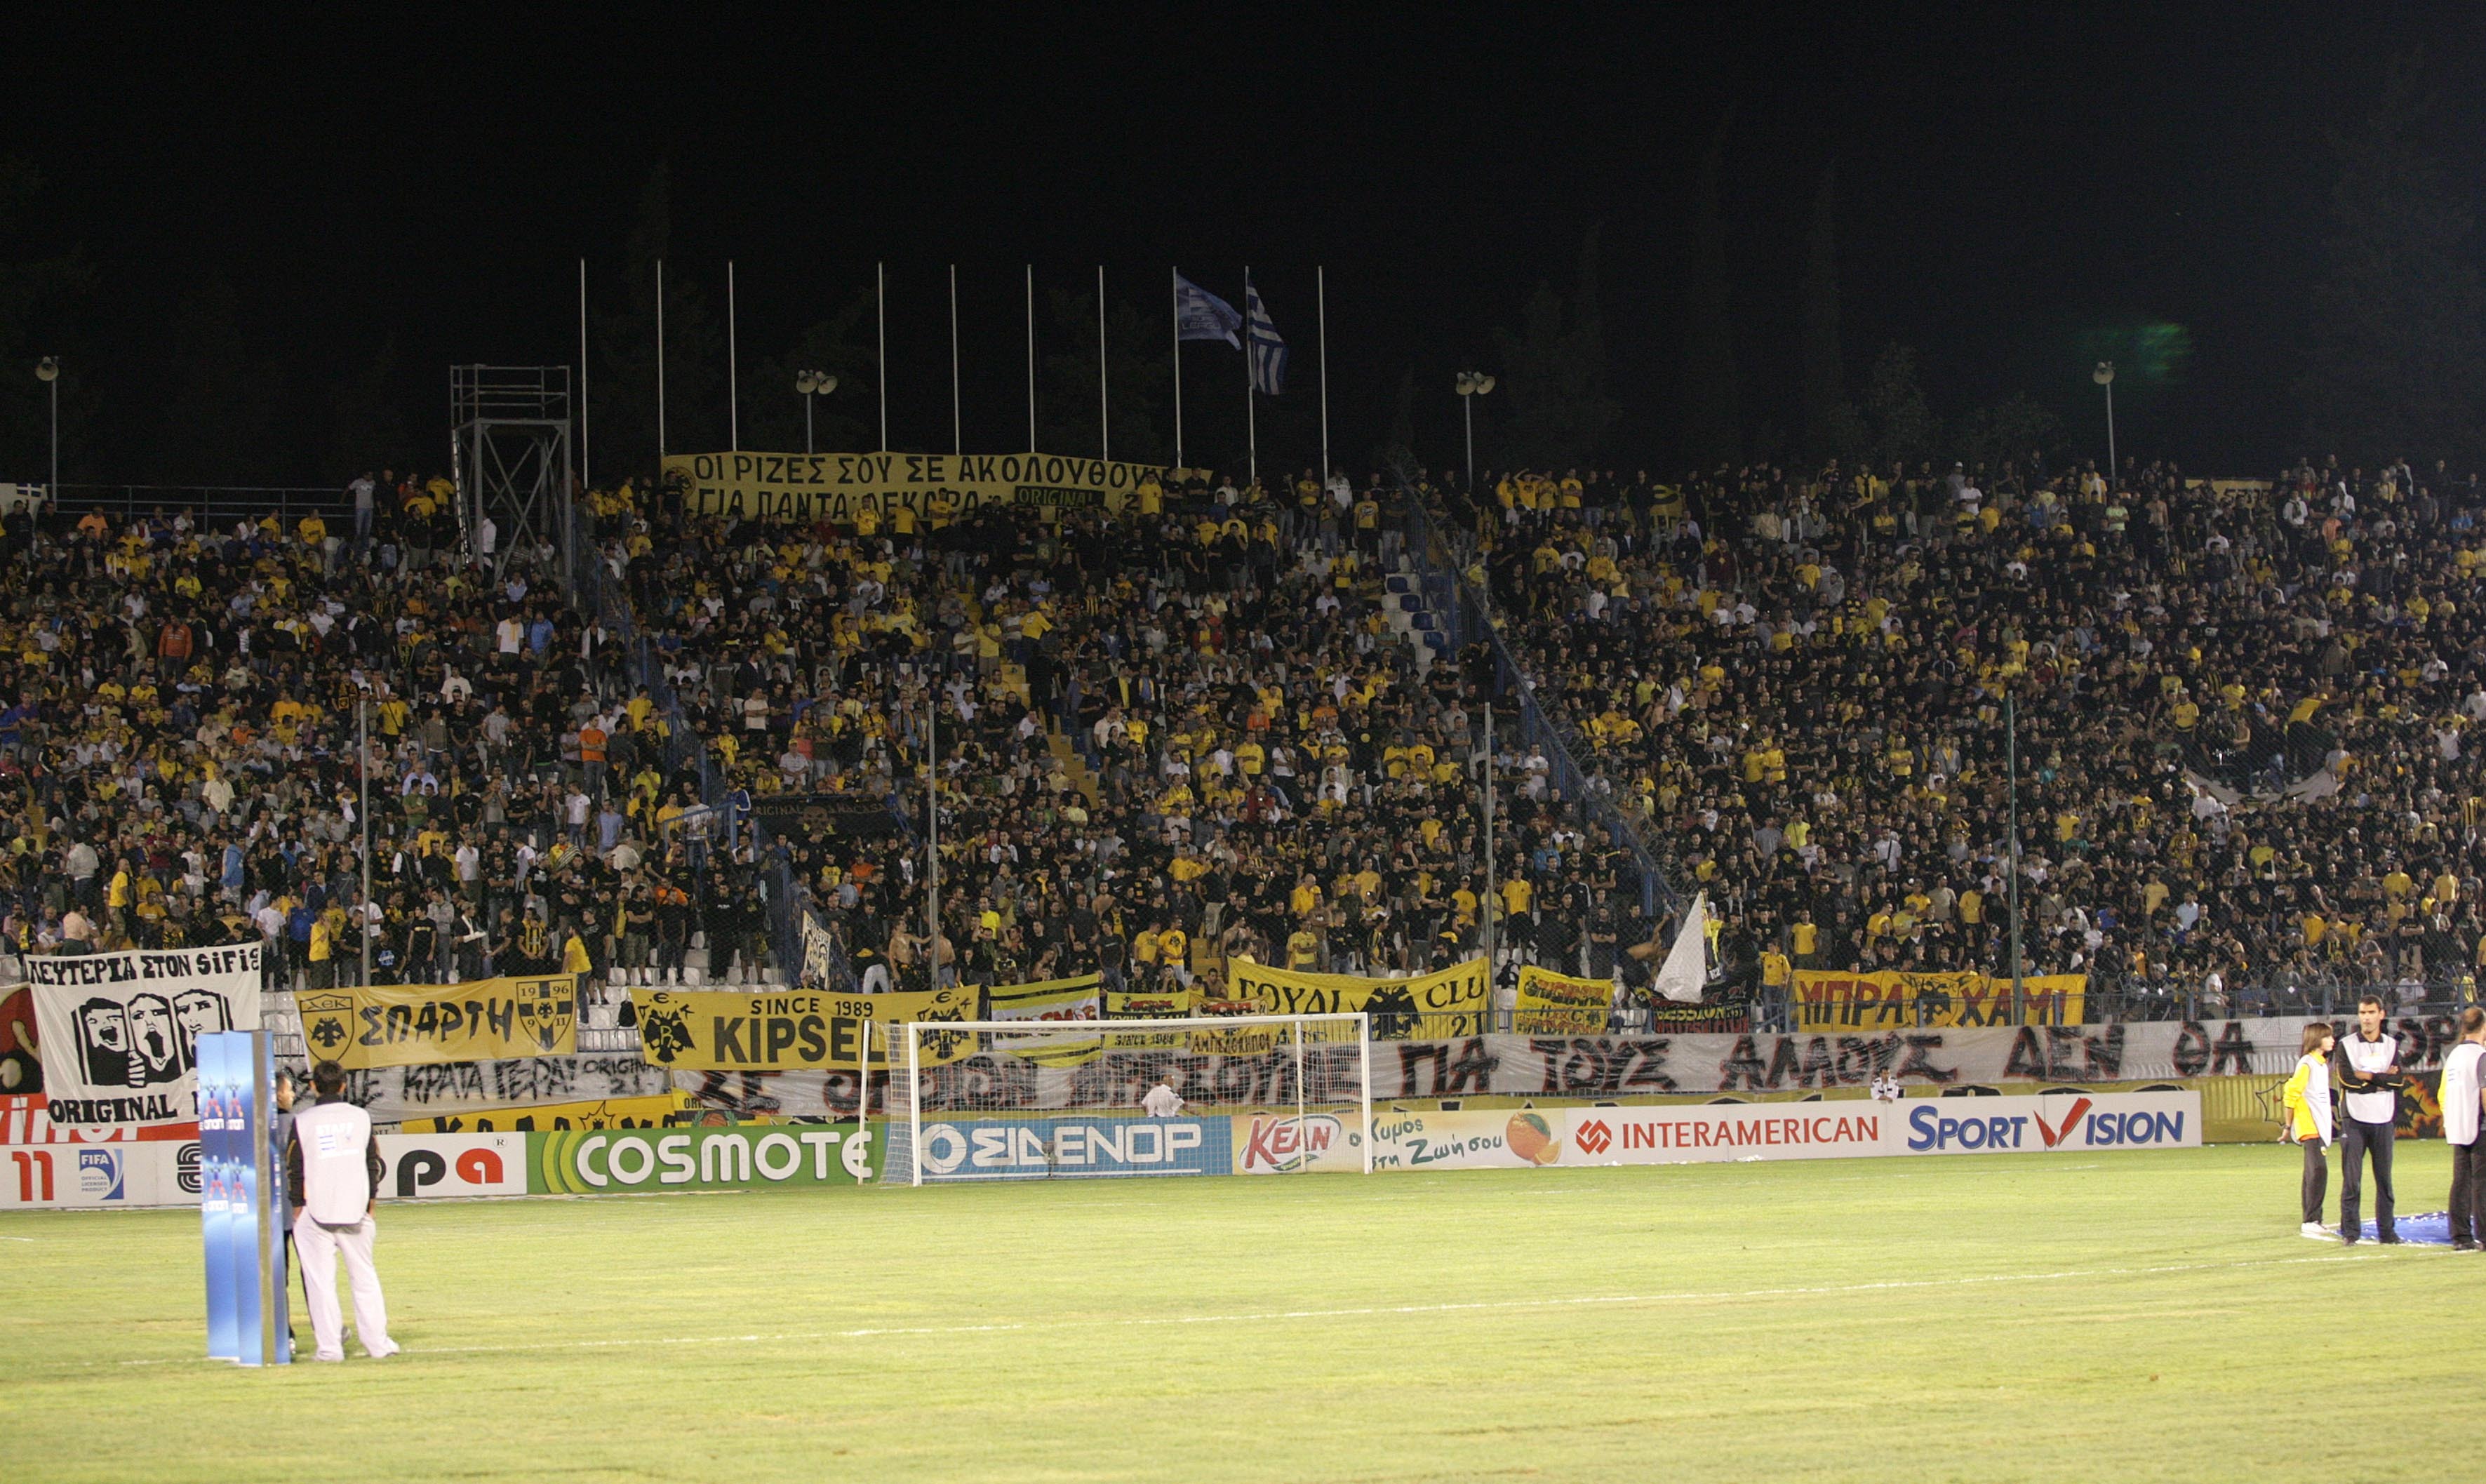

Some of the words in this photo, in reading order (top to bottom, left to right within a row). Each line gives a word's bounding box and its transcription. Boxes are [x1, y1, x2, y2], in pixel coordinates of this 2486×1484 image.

[695, 456, 723, 479] ΟΙ
[734, 456, 824, 483] ΡΙΖΕΣ
[838, 457, 890, 483] ΣΟΥ
[905, 457, 945, 482] ΣΕ
[698, 489, 744, 518] ΓΙΑ
[758, 492, 848, 520] ΠΑΝΤΑ
[28, 956, 138, 986] ΛΕΥΤΕΡΙΑ
[140, 954, 193, 979] ΣΤΟΝ
[520, 987, 536, 997] 19
[553, 984, 569, 995] 96
[1799, 980, 1904, 1026] ΜΠΡΑ
[358, 998, 514, 1047] ΣΠΑΡΤΗ
[751, 997, 820, 1015] SINCE
[835, 1001, 874, 1017] 1989
[1528, 1037, 1678, 1092] ΤΟΥΣ
[2003, 1024, 2125, 1083] ΔΕΝ
[2172, 1019, 2257, 1077] ΘΑ
[47, 1093, 178, 1123] ORIGINAL
[1245, 1117, 1332, 1169] KEAN
[1622, 1116, 1880, 1149] INTERAMERICAN
[1907, 1104, 2028, 1151] SPORT
[81, 1154, 109, 1165] FIFA
[575, 1130, 872, 1186] COSMOTE
[1405, 1133, 1465, 1165] Ζωή
[1468, 1134, 1503, 1152] σου
